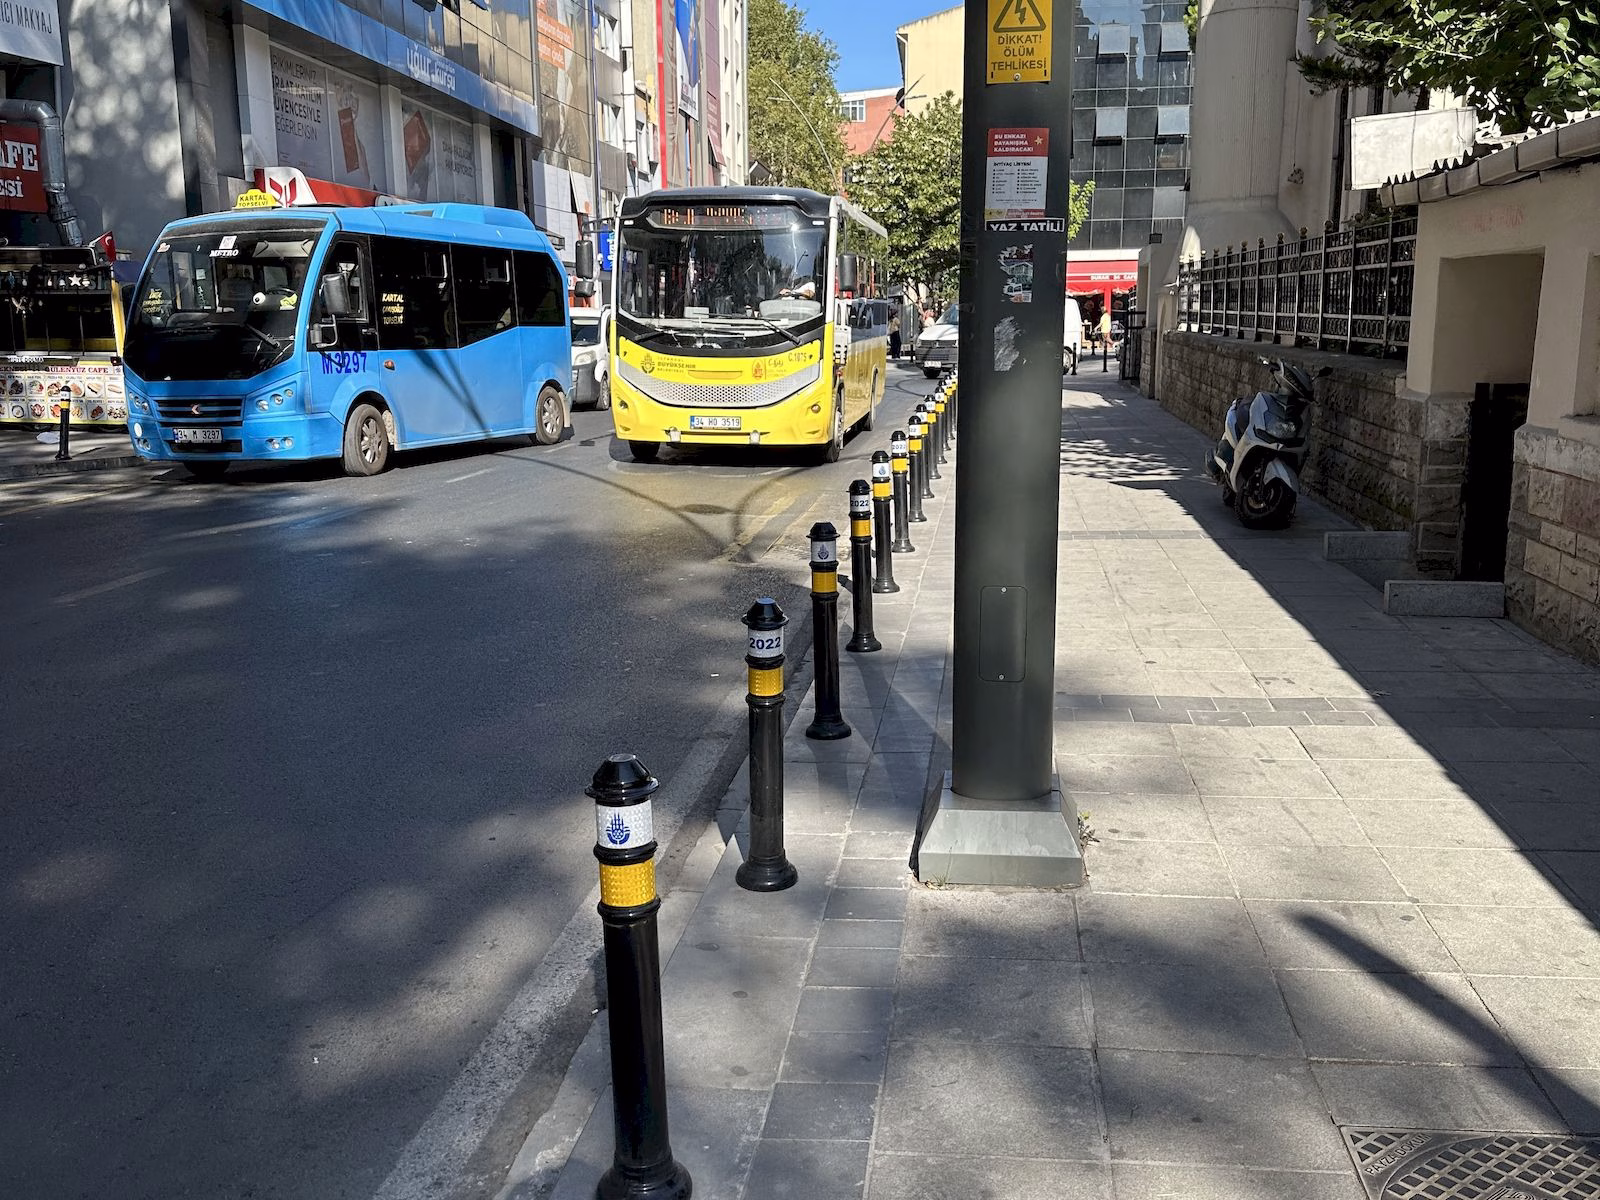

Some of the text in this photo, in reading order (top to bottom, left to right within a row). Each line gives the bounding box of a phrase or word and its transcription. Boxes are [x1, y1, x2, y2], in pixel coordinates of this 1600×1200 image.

[0, 1, 53, 34] ICI MAKYAJ
[997, 34, 1042, 45] DİKKAT!
[1003, 45, 1035, 57] ÖLÜM
[406, 43, 431, 80] uğur
[991, 57, 1047, 71] TEHLİKESİ
[239, 194, 267, 202] KARTAL
[989, 222, 1018, 232] YAZ
[209, 249, 239, 257] METRO
[382, 292, 405, 303] KARTAL
[321, 352, 367, 375] M3297
[695, 417, 704, 426] 34
[721, 417, 740, 427] 3519
[178, 429, 220, 440] 34 M 3297
[850, 499, 870, 507] 2022
[749, 636, 782, 651] 2022
[1364, 1153, 1398, 1176] PAYZA
